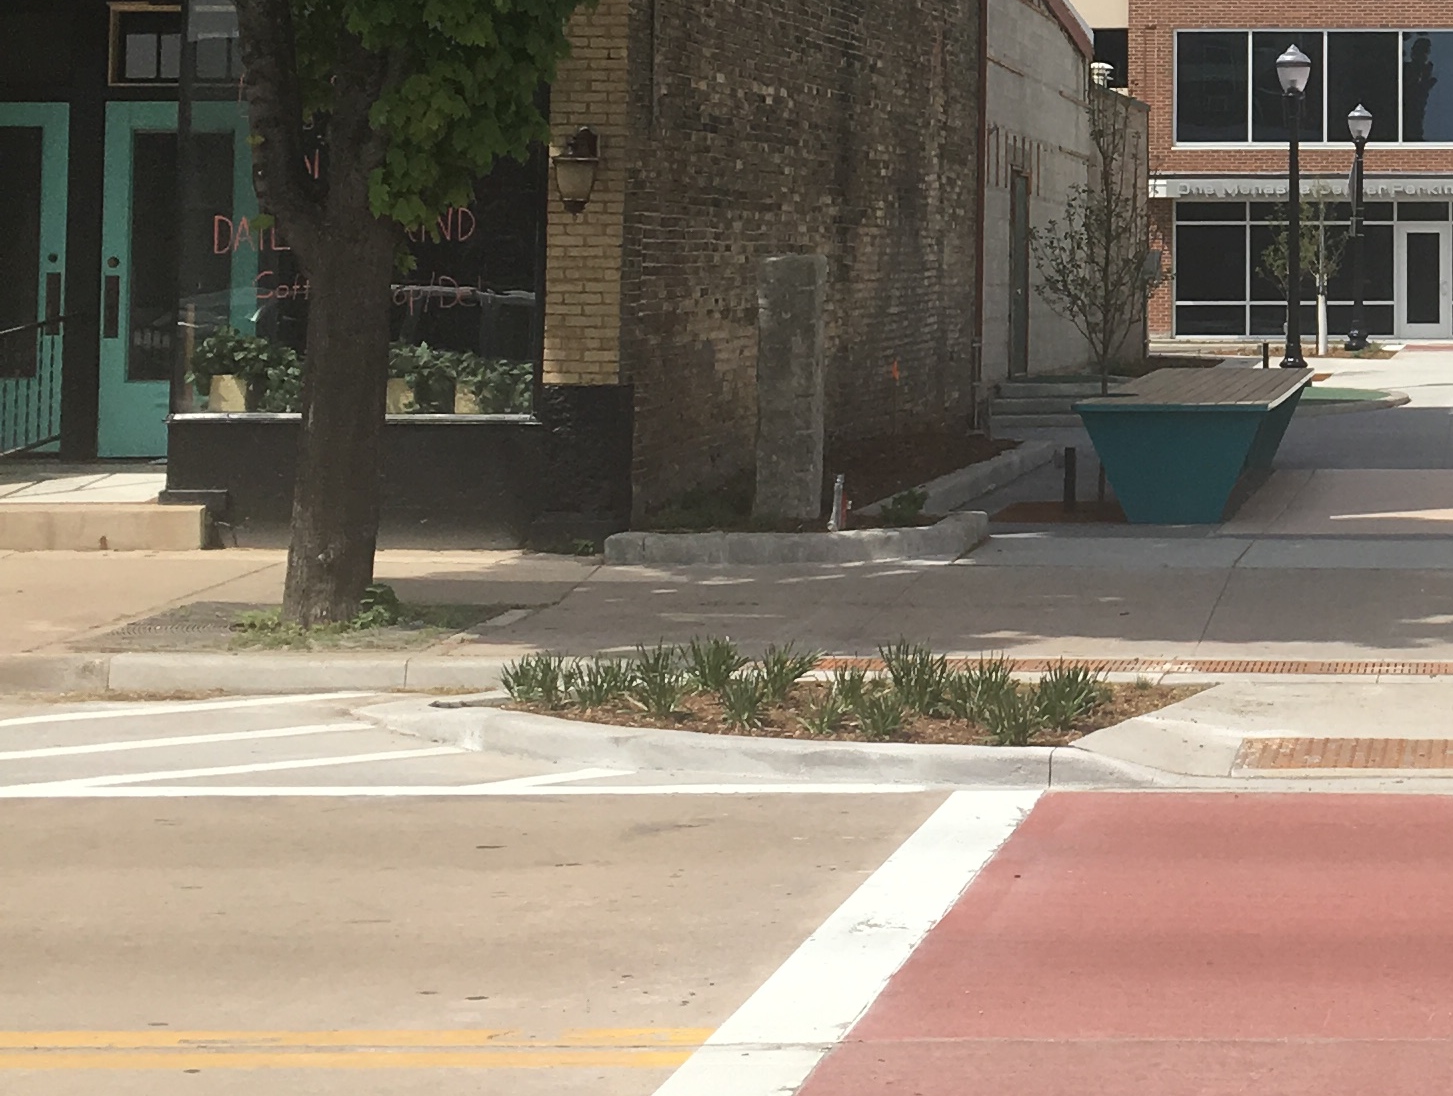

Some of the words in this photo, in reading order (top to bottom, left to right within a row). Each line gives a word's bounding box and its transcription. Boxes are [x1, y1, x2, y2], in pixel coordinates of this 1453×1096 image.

[1178, 182, 1215, 196] One
[1222, 182, 1310, 196] Menasa
[213, 215, 291, 254] DAIL
